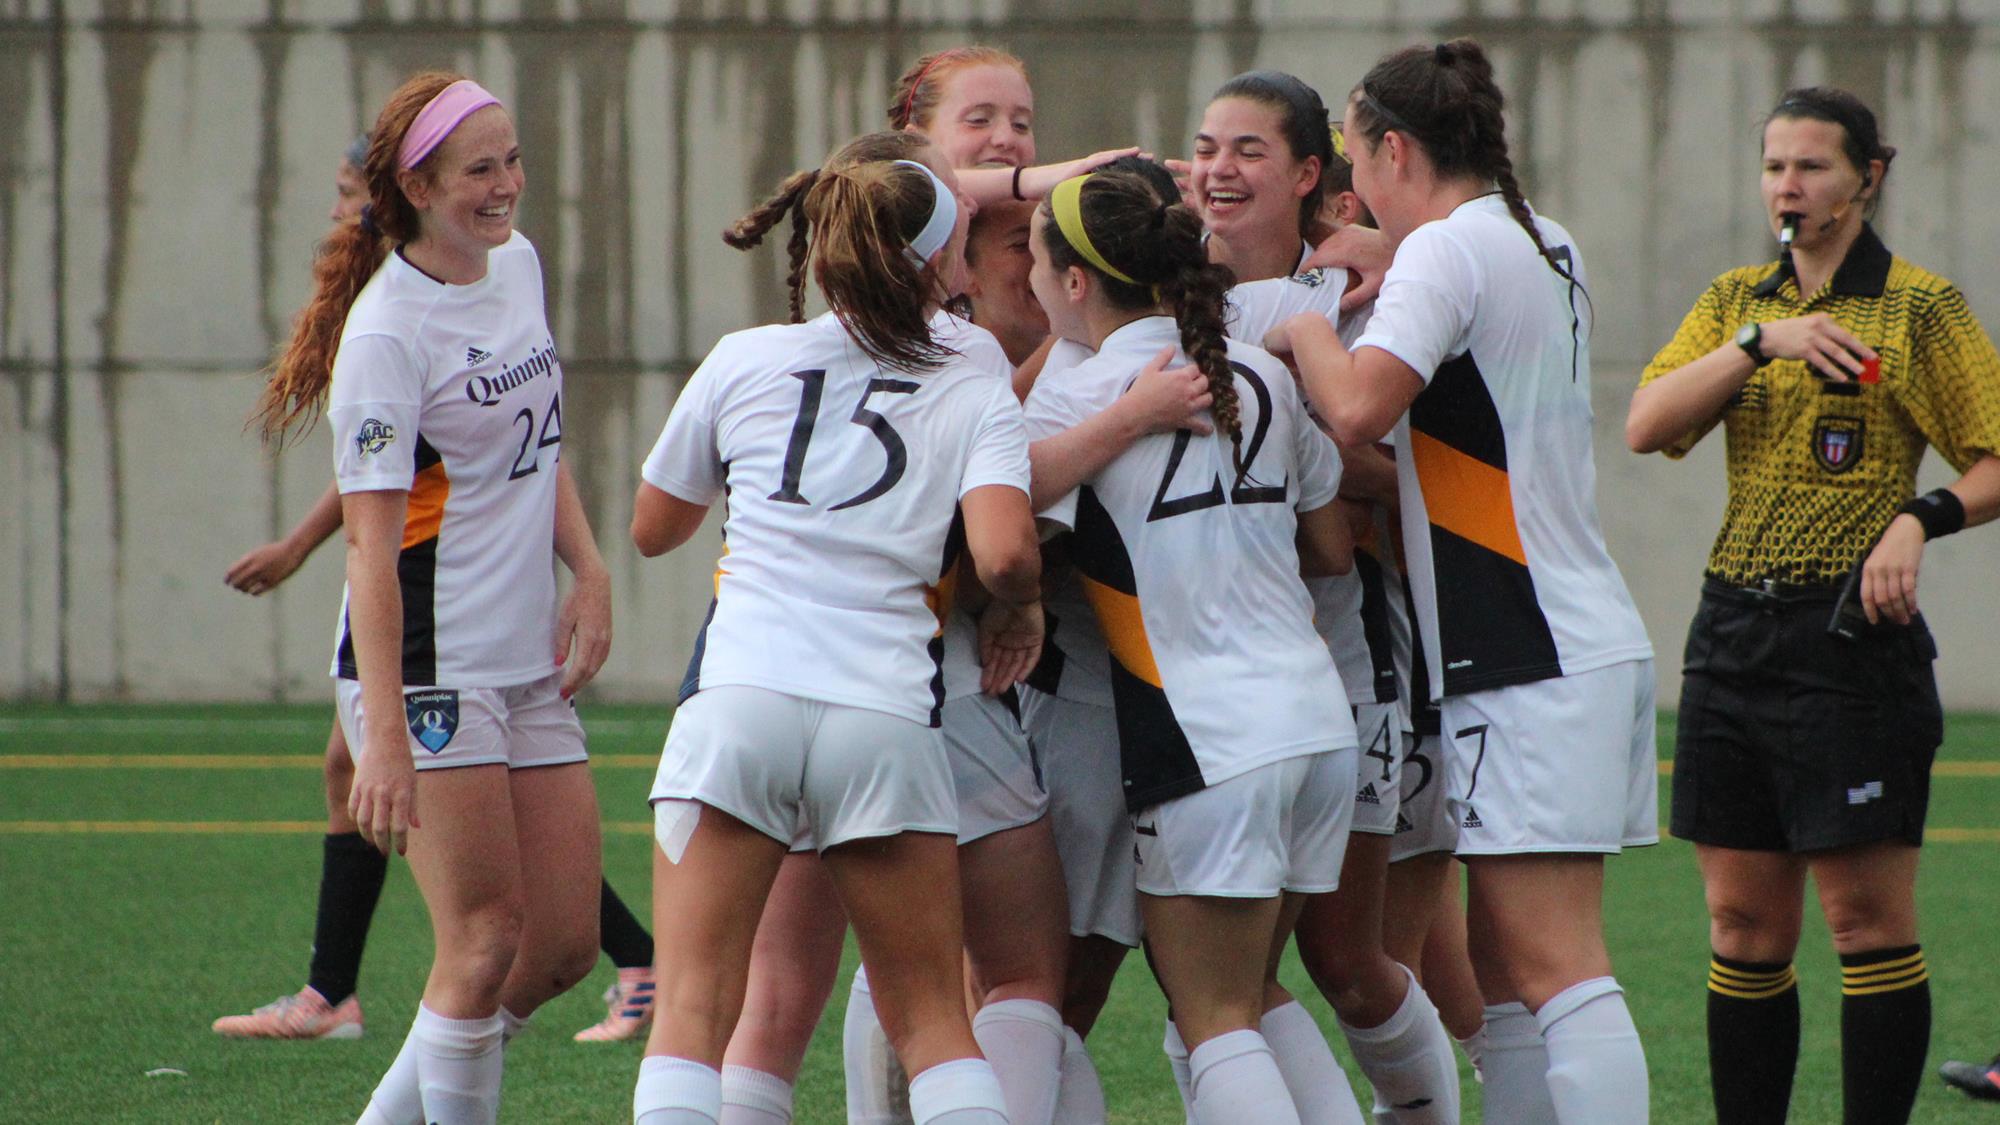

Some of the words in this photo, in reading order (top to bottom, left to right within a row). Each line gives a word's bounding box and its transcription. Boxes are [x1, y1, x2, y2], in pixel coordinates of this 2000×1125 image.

[1539, 244, 1579, 384] 7
[508, 391, 562, 481] 24
[766, 369, 922, 512] 15
[422, 710, 448, 734] Q
[1365, 713, 1395, 783] 4
[1455, 723, 1489, 800] 7
